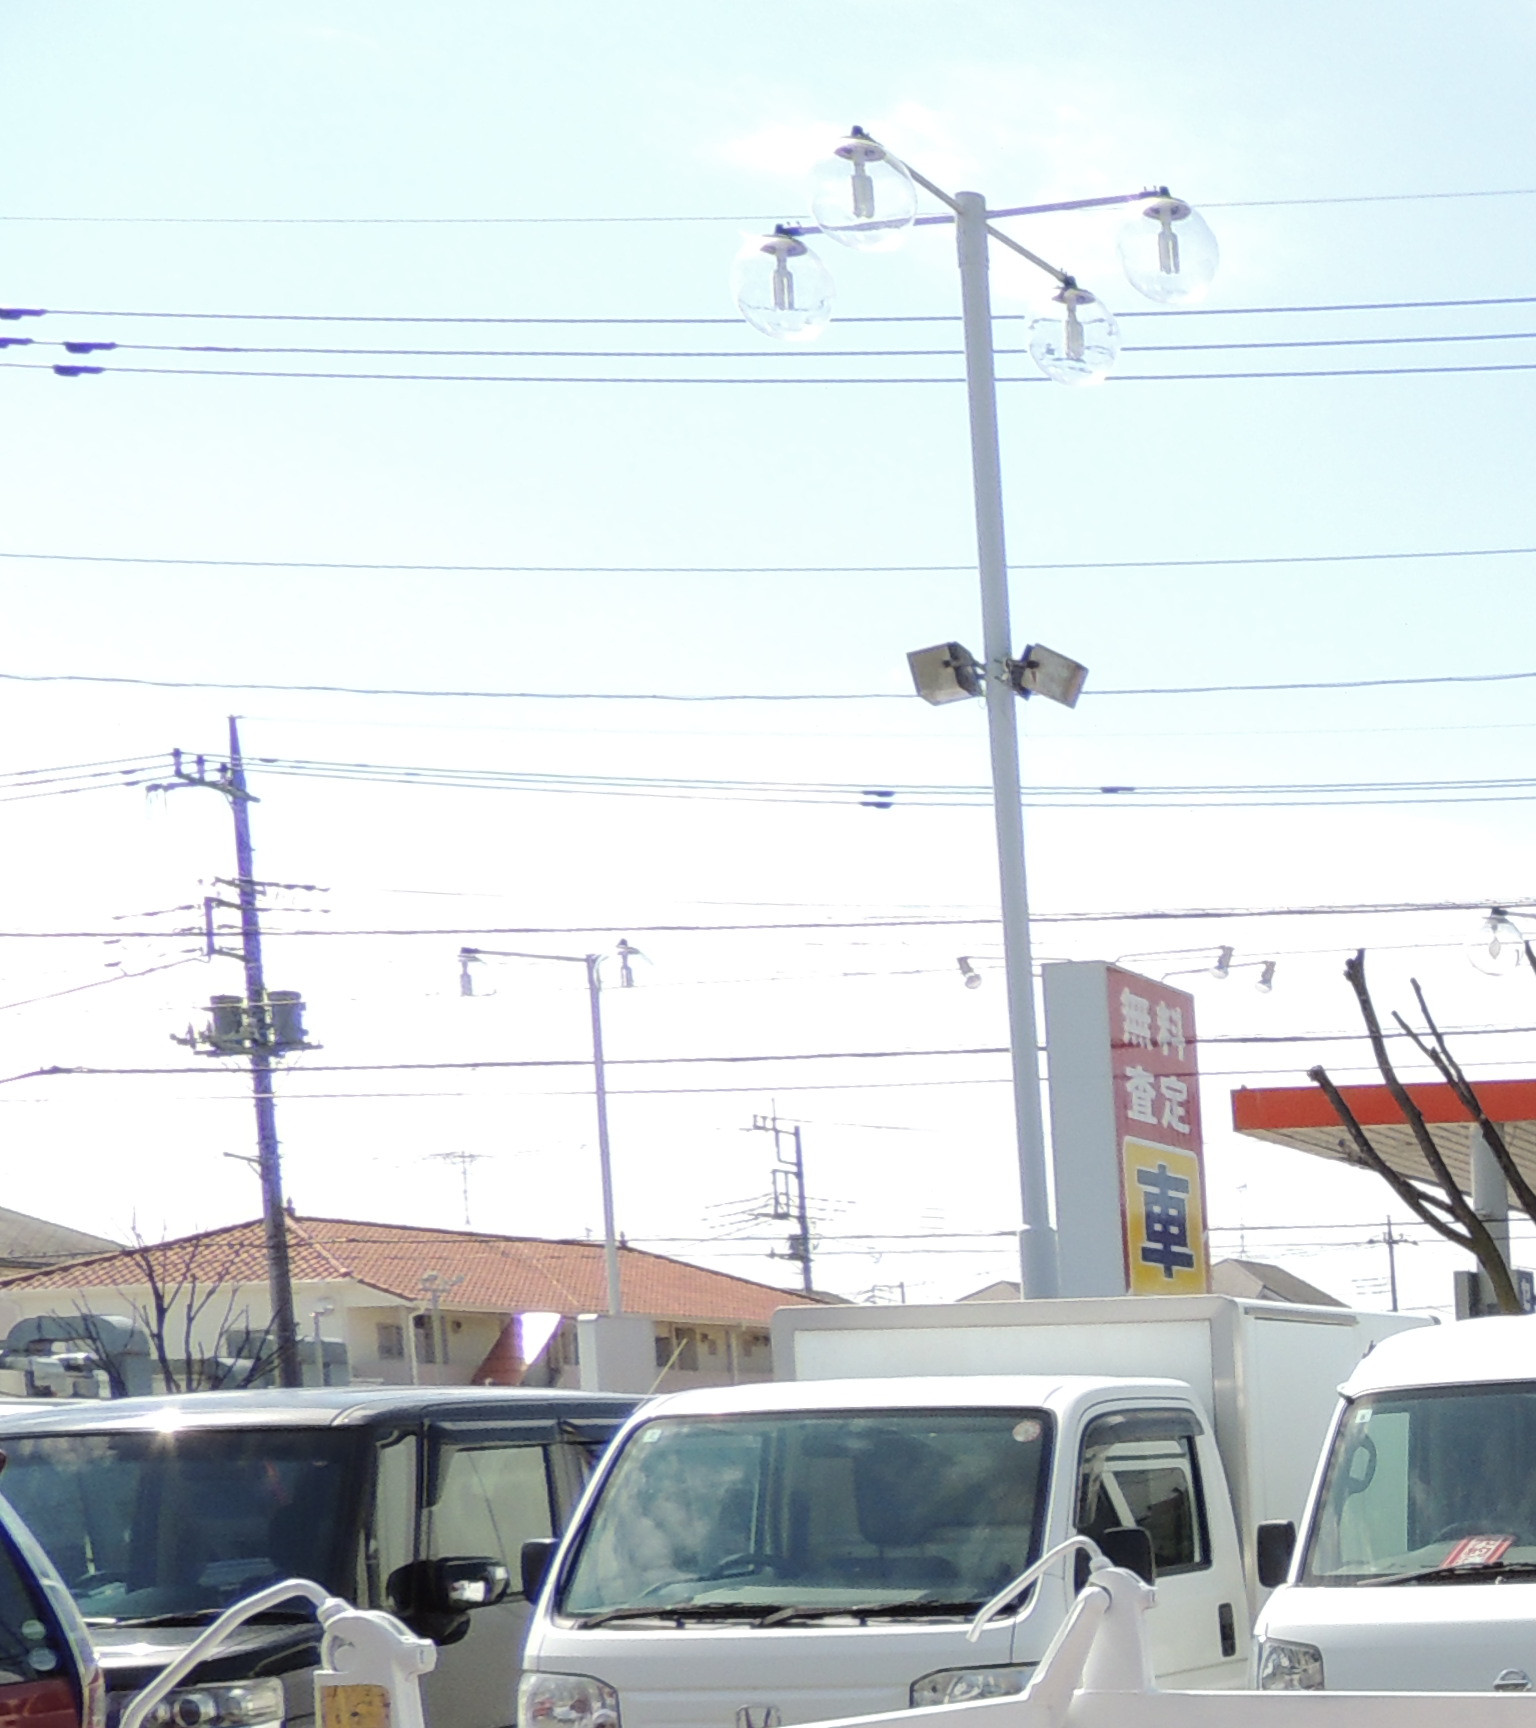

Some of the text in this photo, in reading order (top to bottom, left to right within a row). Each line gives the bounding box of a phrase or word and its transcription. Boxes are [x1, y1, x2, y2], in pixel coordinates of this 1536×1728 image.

[1120, 987, 1186, 1060] 無料
[1125, 1065, 1191, 1134] 査定
[1137, 1163, 1195, 1279] 車
